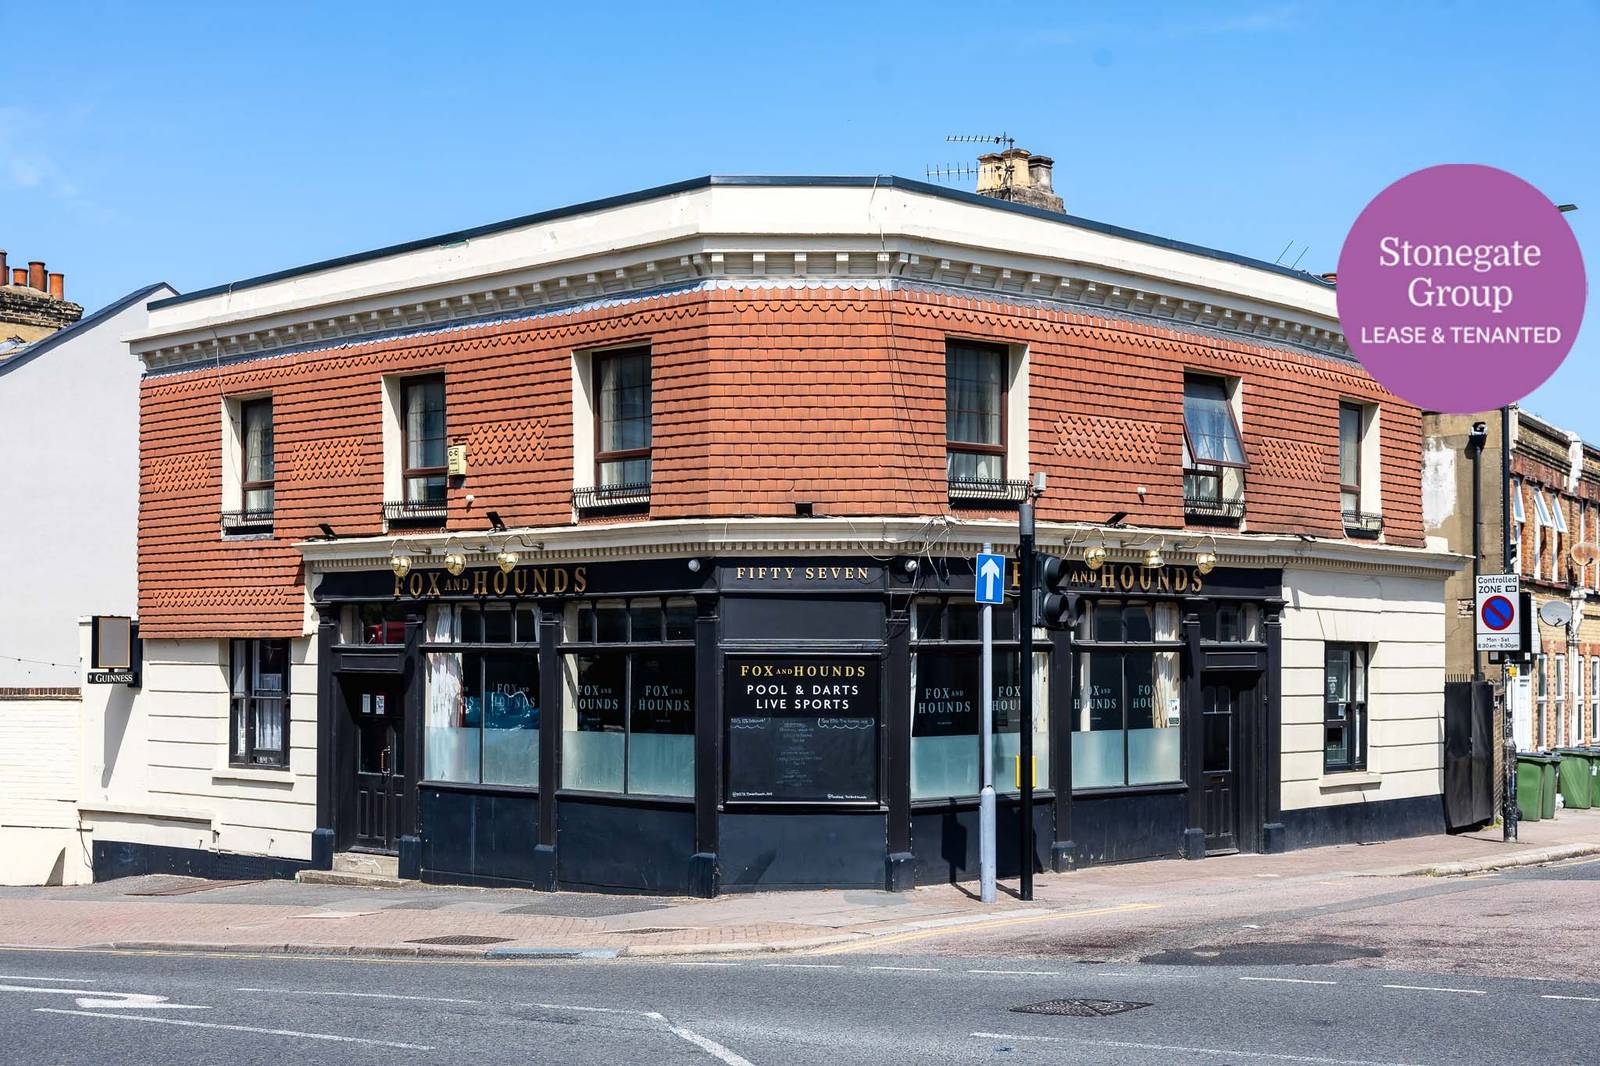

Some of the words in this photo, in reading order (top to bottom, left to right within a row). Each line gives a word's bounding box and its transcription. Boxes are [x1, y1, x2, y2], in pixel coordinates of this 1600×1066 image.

[736, 567, 795, 579] FIFTY
[805, 567, 870, 579] SEVEN
[1071, 570, 1097, 583] AND
[1101, 563, 1203, 592] HOUNDS
[393, 572, 441, 596] FOX
[444, 578, 470, 591] AND
[473, 567, 587, 596] HOUNDS
[1478, 576, 1517, 584] Controlled
[1478, 585, 1502, 593] ZONE
[741, 665, 774, 677] FOX
[794, 665, 866, 677] HOUNDS
[95, 673, 133, 683] GUINNESS
[577, 685, 599, 696] FOX
[645, 685, 669, 696] FOX
[747, 684, 788, 695] POOL
[795, 685, 804, 695] &
[812, 685, 859, 695] DARTS
[925, 688, 950, 699] FOX
[999, 686, 1021, 697] FOX
[573, 699, 619, 710] OUNDS
[638, 699, 690, 711] HOUNDS
[756, 699, 787, 709] LIVE
[795, 699, 849, 709] SPORTS
[918, 701, 971, 713] HOUNDS
[992, 699, 1021, 710] HOU
[1074, 698, 1117, 709] HUNDS
